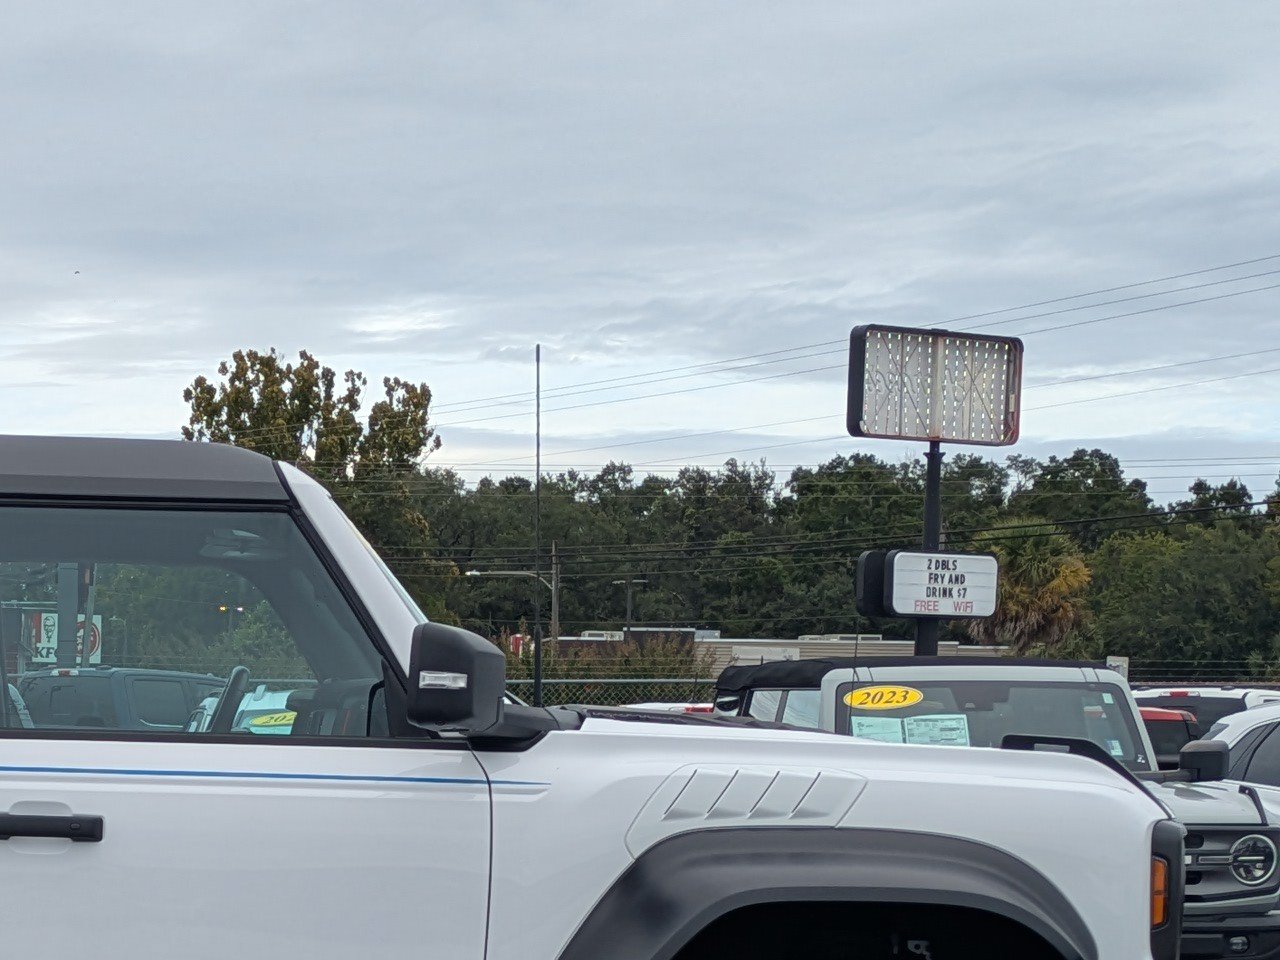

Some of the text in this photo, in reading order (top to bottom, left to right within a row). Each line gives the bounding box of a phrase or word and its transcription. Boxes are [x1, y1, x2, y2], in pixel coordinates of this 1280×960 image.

[927, 559, 957, 571] 2 DBLS
[928, 573, 965, 585] FRY AND
[926, 587, 967, 599] DRINK $7
[915, 600, 939, 612] FREE
[36, 646, 57, 658] KF
[858, 690, 909, 706] 2023
